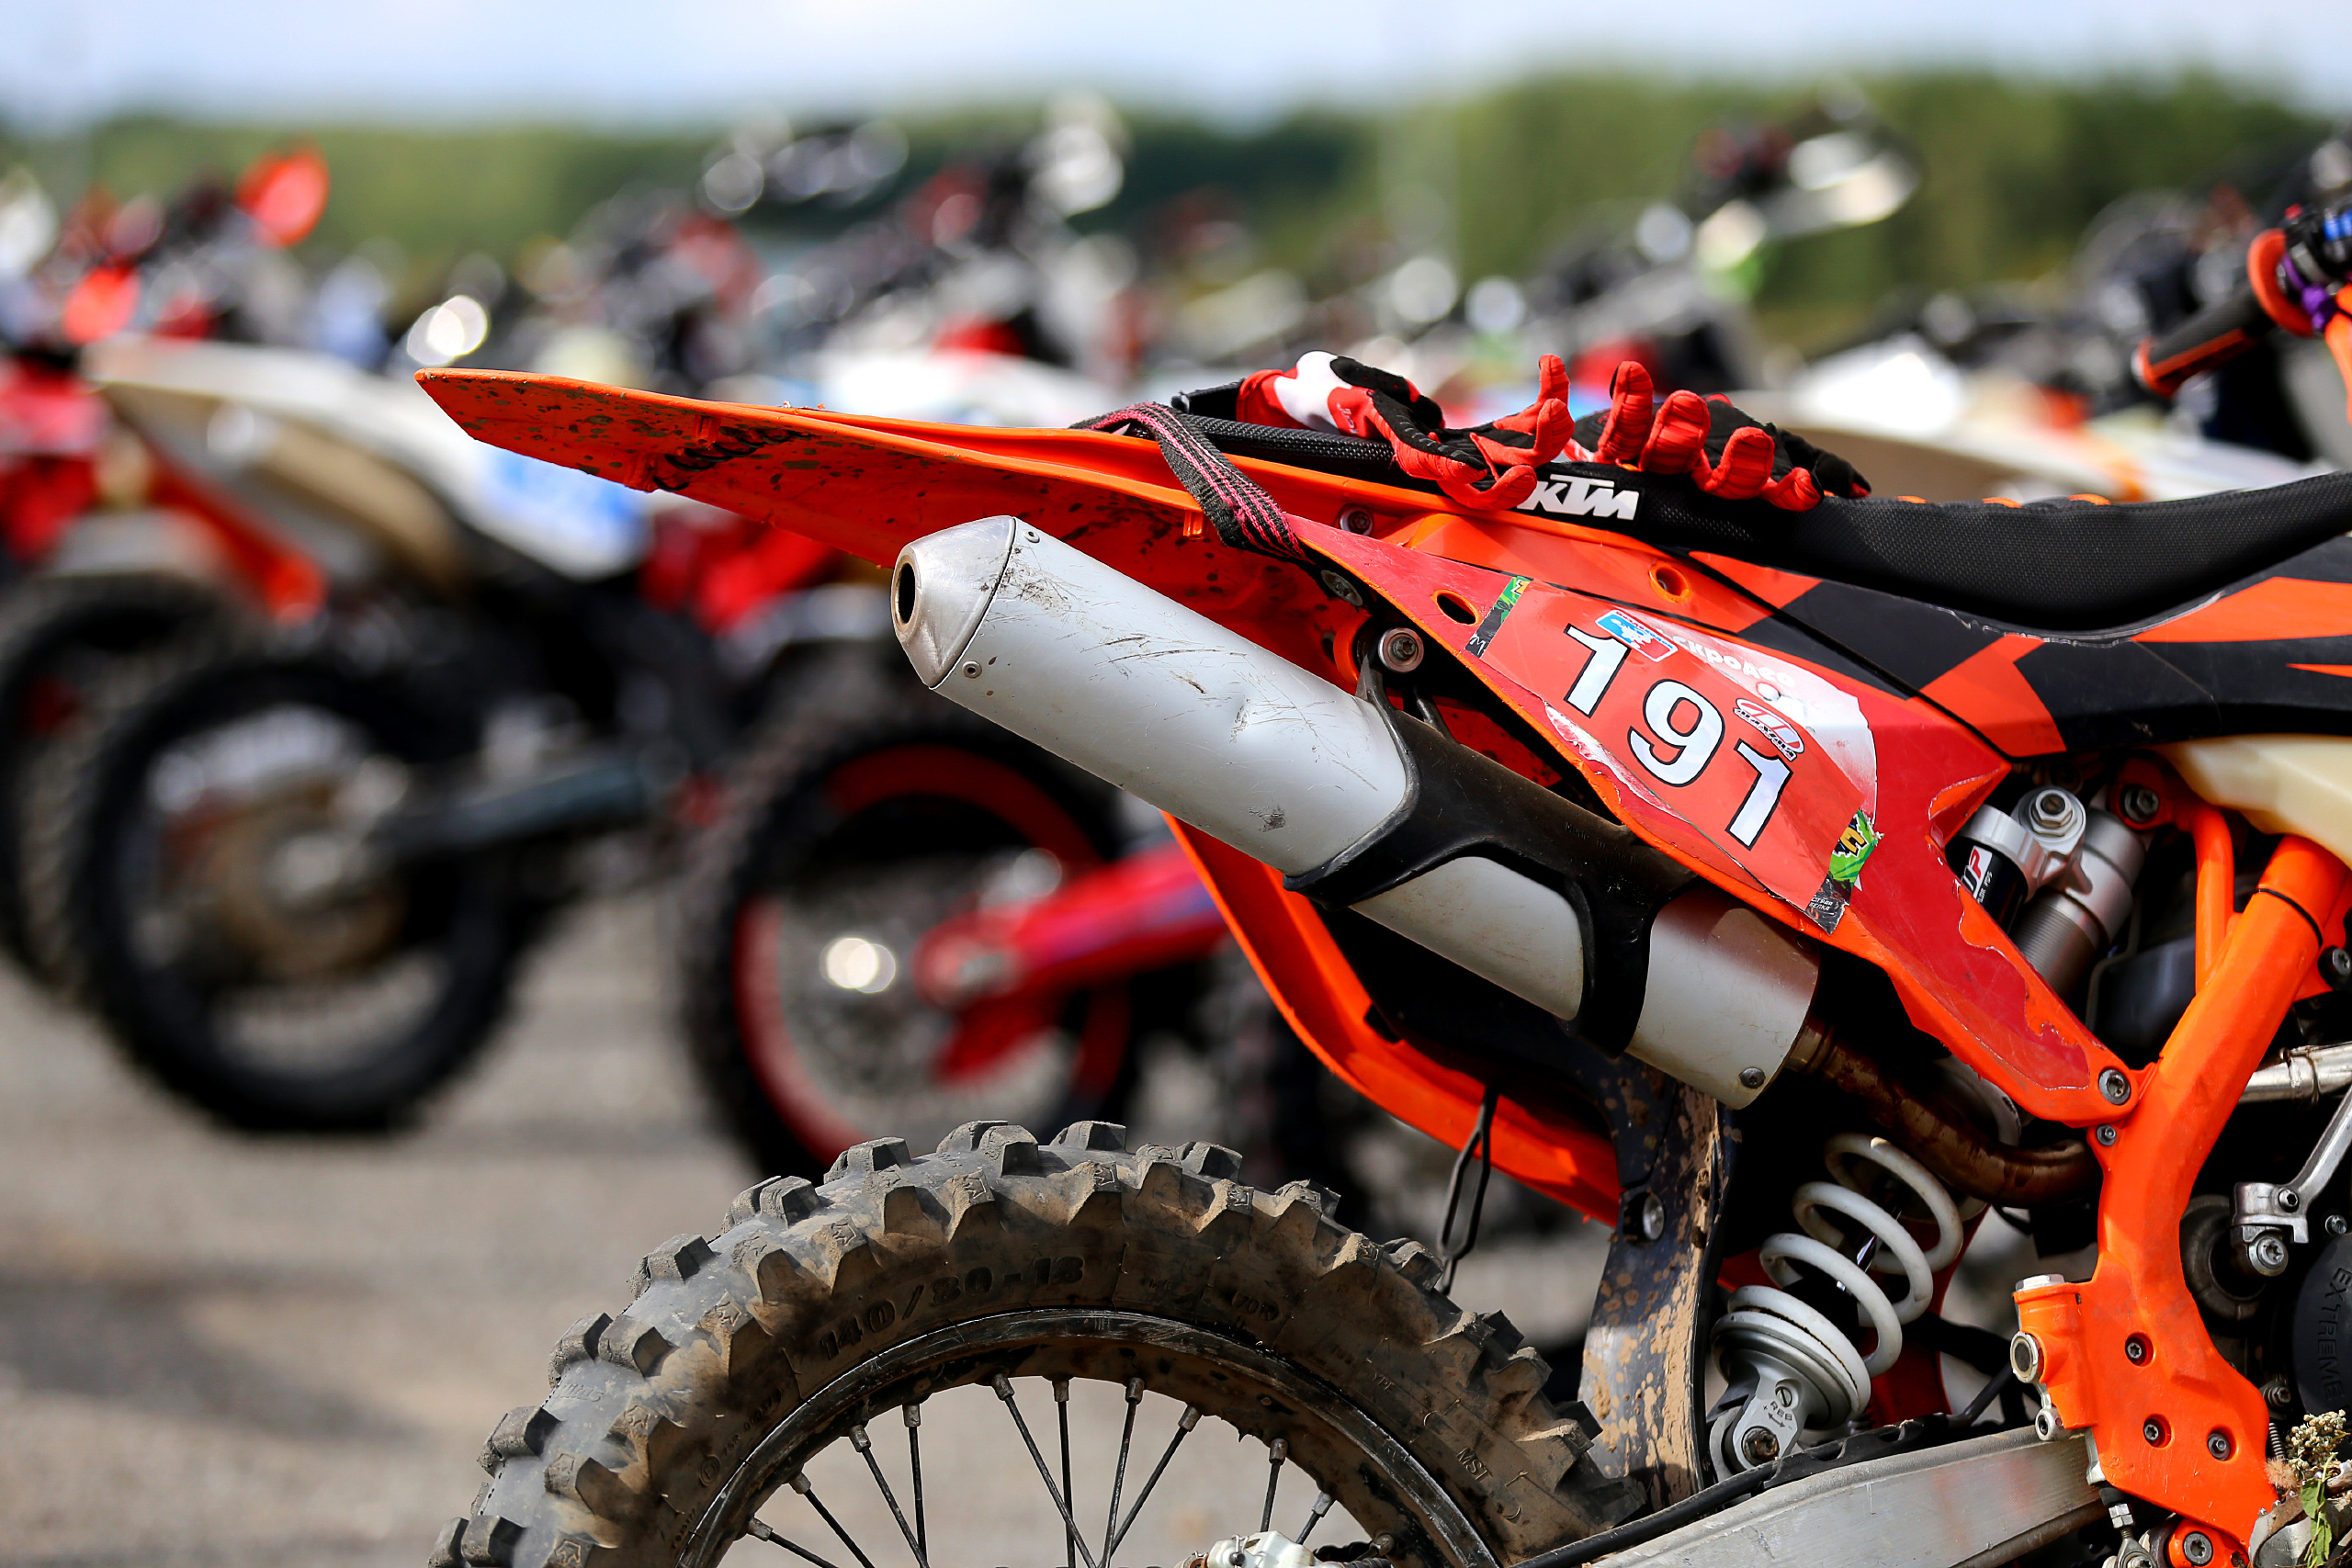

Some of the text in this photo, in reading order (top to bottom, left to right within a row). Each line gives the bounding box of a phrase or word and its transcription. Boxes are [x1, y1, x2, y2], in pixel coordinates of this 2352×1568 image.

[1517, 473, 1640, 521] KTM
[1564, 623, 1796, 851] 191
[819, 1255, 1085, 1361] 140/80-18
[2317, 1267, 2352, 1401] EXTREME
[1770, 1400, 1792, 1422] REB
